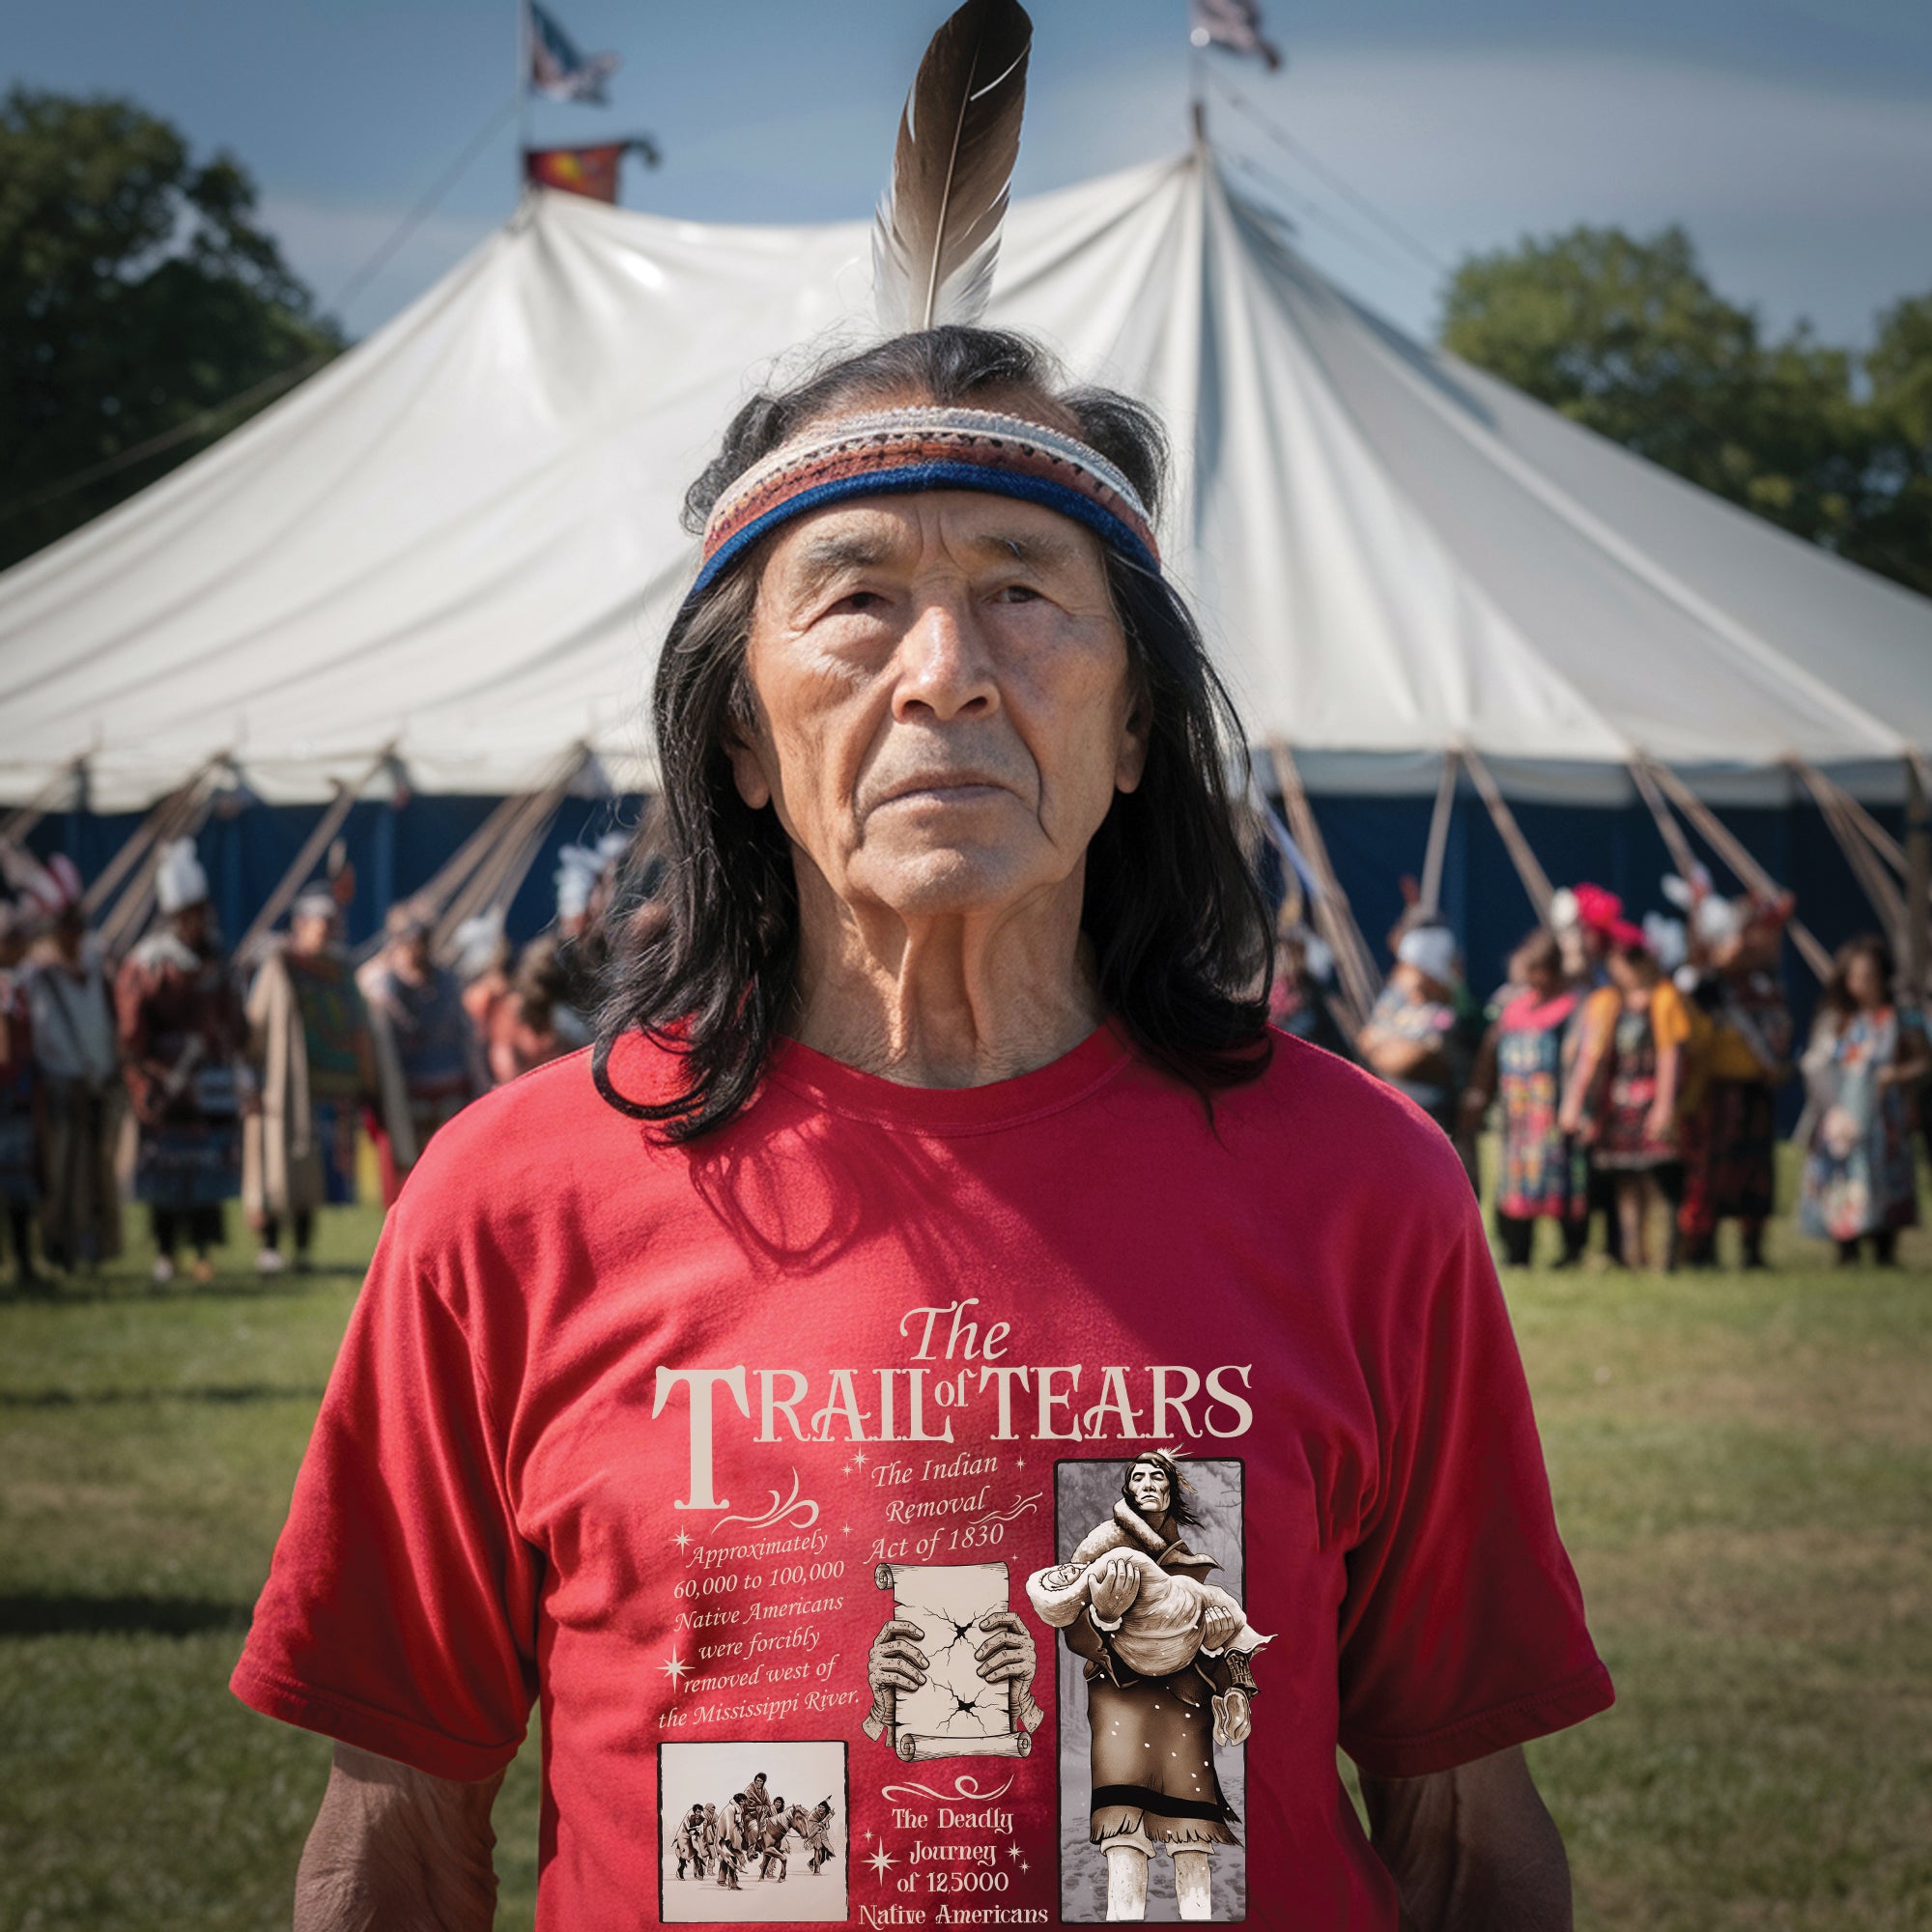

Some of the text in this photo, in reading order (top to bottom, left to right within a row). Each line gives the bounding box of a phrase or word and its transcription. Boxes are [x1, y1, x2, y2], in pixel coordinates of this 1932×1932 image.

[899, 1297, 1010, 1360] The
[651, 1363, 1254, 1510] TRAIL of TEARS
[871, 1452, 998, 1487] The Indian
[886, 1486, 990, 1524] Removal
[686, 1528, 828, 1569] Approximately
[863, 1522, 1005, 1565] Act of 1830
[673, 1560, 845, 1600] 60,000 to 100,000
[673, 1596, 844, 1633] Native Americans
[698, 1625, 820, 1661] were forcibly
[684, 1654, 840, 1693] removed west of
[659, 1690, 860, 1729] the Mississippi River.
[891, 1807, 1014, 1834] The Deadly
[909, 1840, 997, 1866] Journey
[896, 1872, 921, 1892] of
[858, 1904, 1048, 1931] Native Americans
